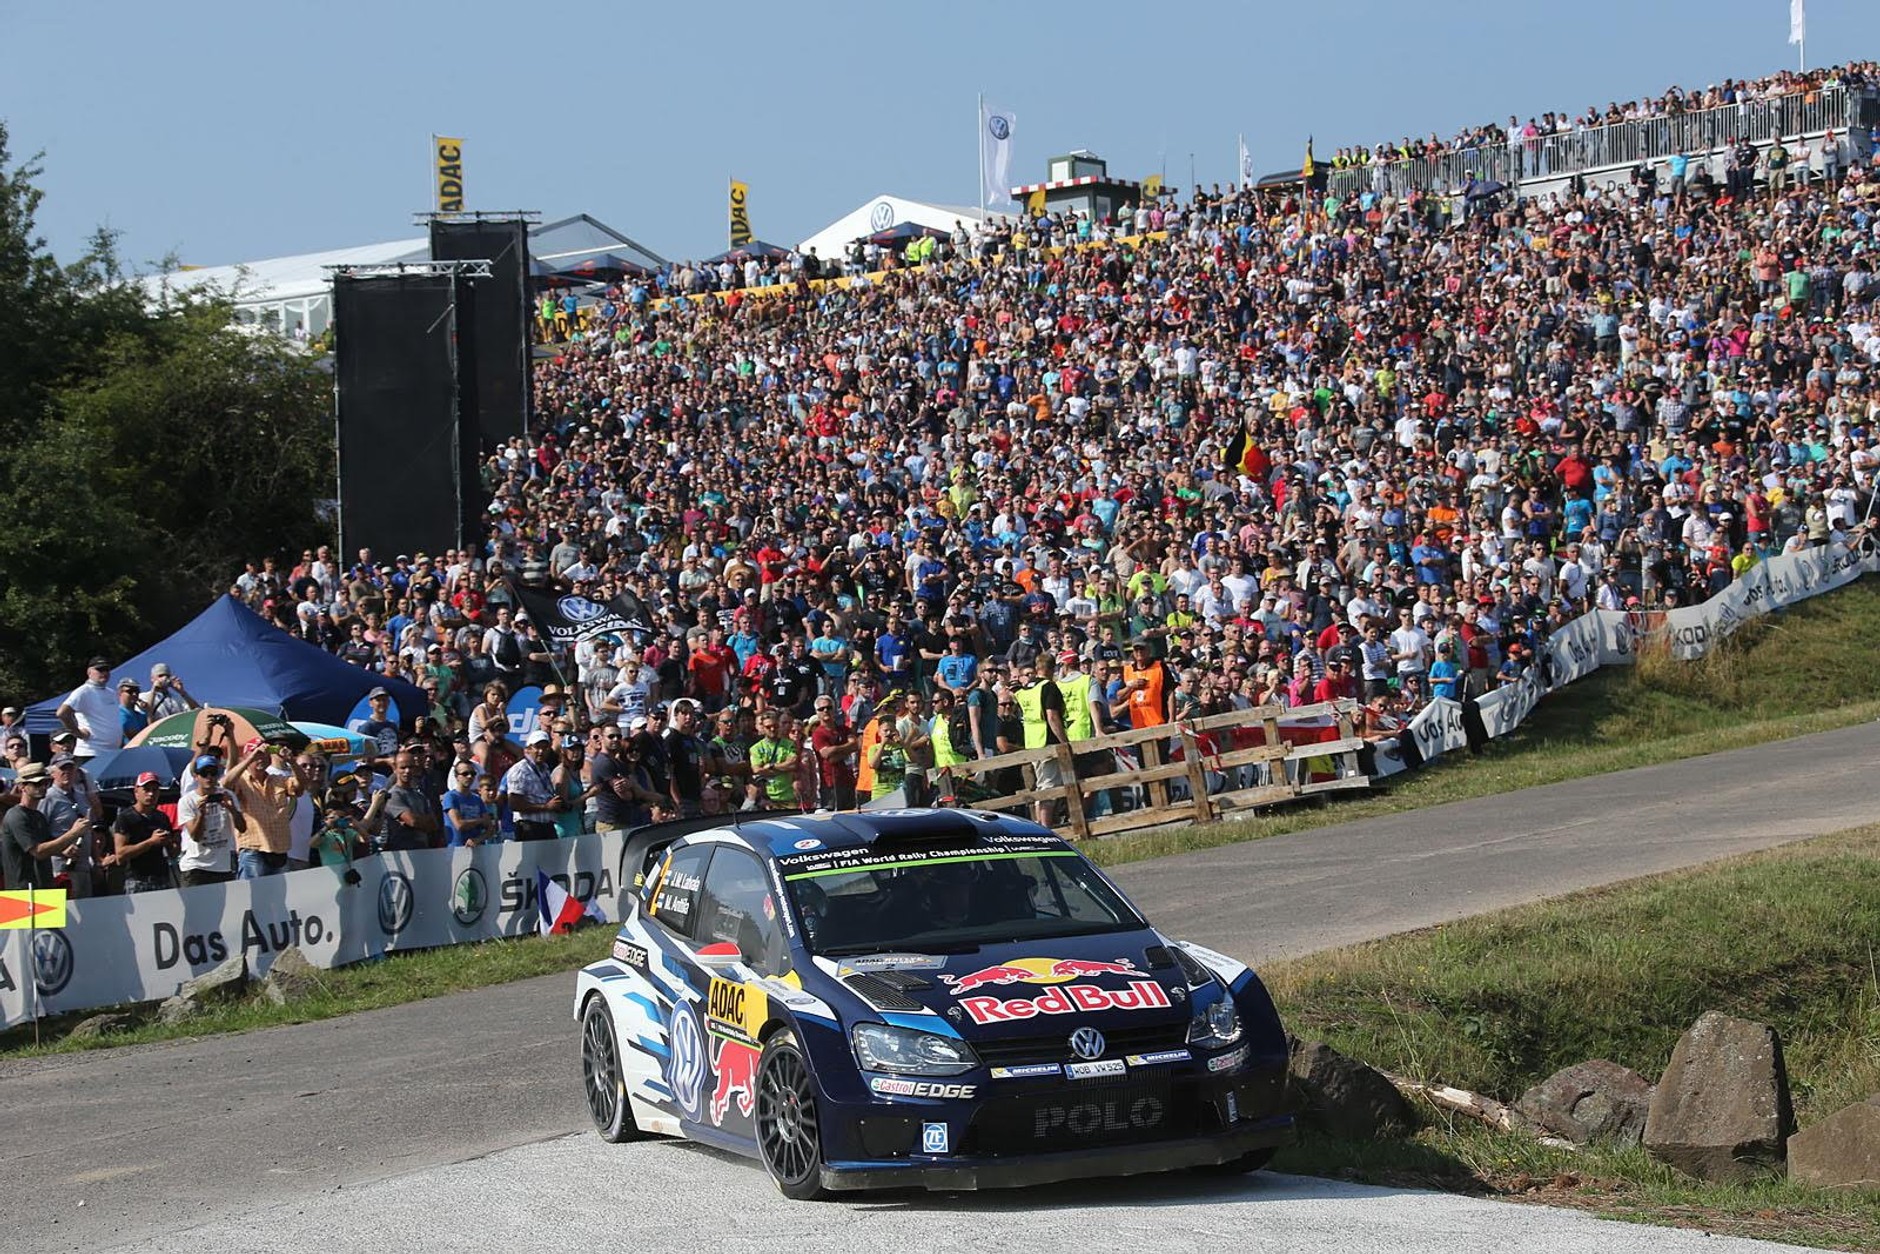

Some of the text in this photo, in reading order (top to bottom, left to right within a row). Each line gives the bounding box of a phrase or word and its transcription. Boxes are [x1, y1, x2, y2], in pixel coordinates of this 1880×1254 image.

[982, 836, 1062, 845] Volkswagen
[779, 847, 869, 866] Volkswagen
[840, 859, 860, 868] FIA
[861, 853, 896, 865] World
[899, 851, 927, 862] Rally
[930, 845, 1005, 858] Championship
[153, 909, 333, 970] Das Auto.
[626, 946, 648, 968] EDGE
[710, 981, 745, 1025] ADAC
[960, 981, 1171, 1024] Red Bull
[1146, 1052, 1189, 1062] MICHELIN
[1012, 1065, 1058, 1075] MICHELIN
[1073, 1065, 1091, 1075] WOB
[880, 1079, 977, 1099] Castrol EDGE
[1034, 1098, 1163, 1138] POLO
